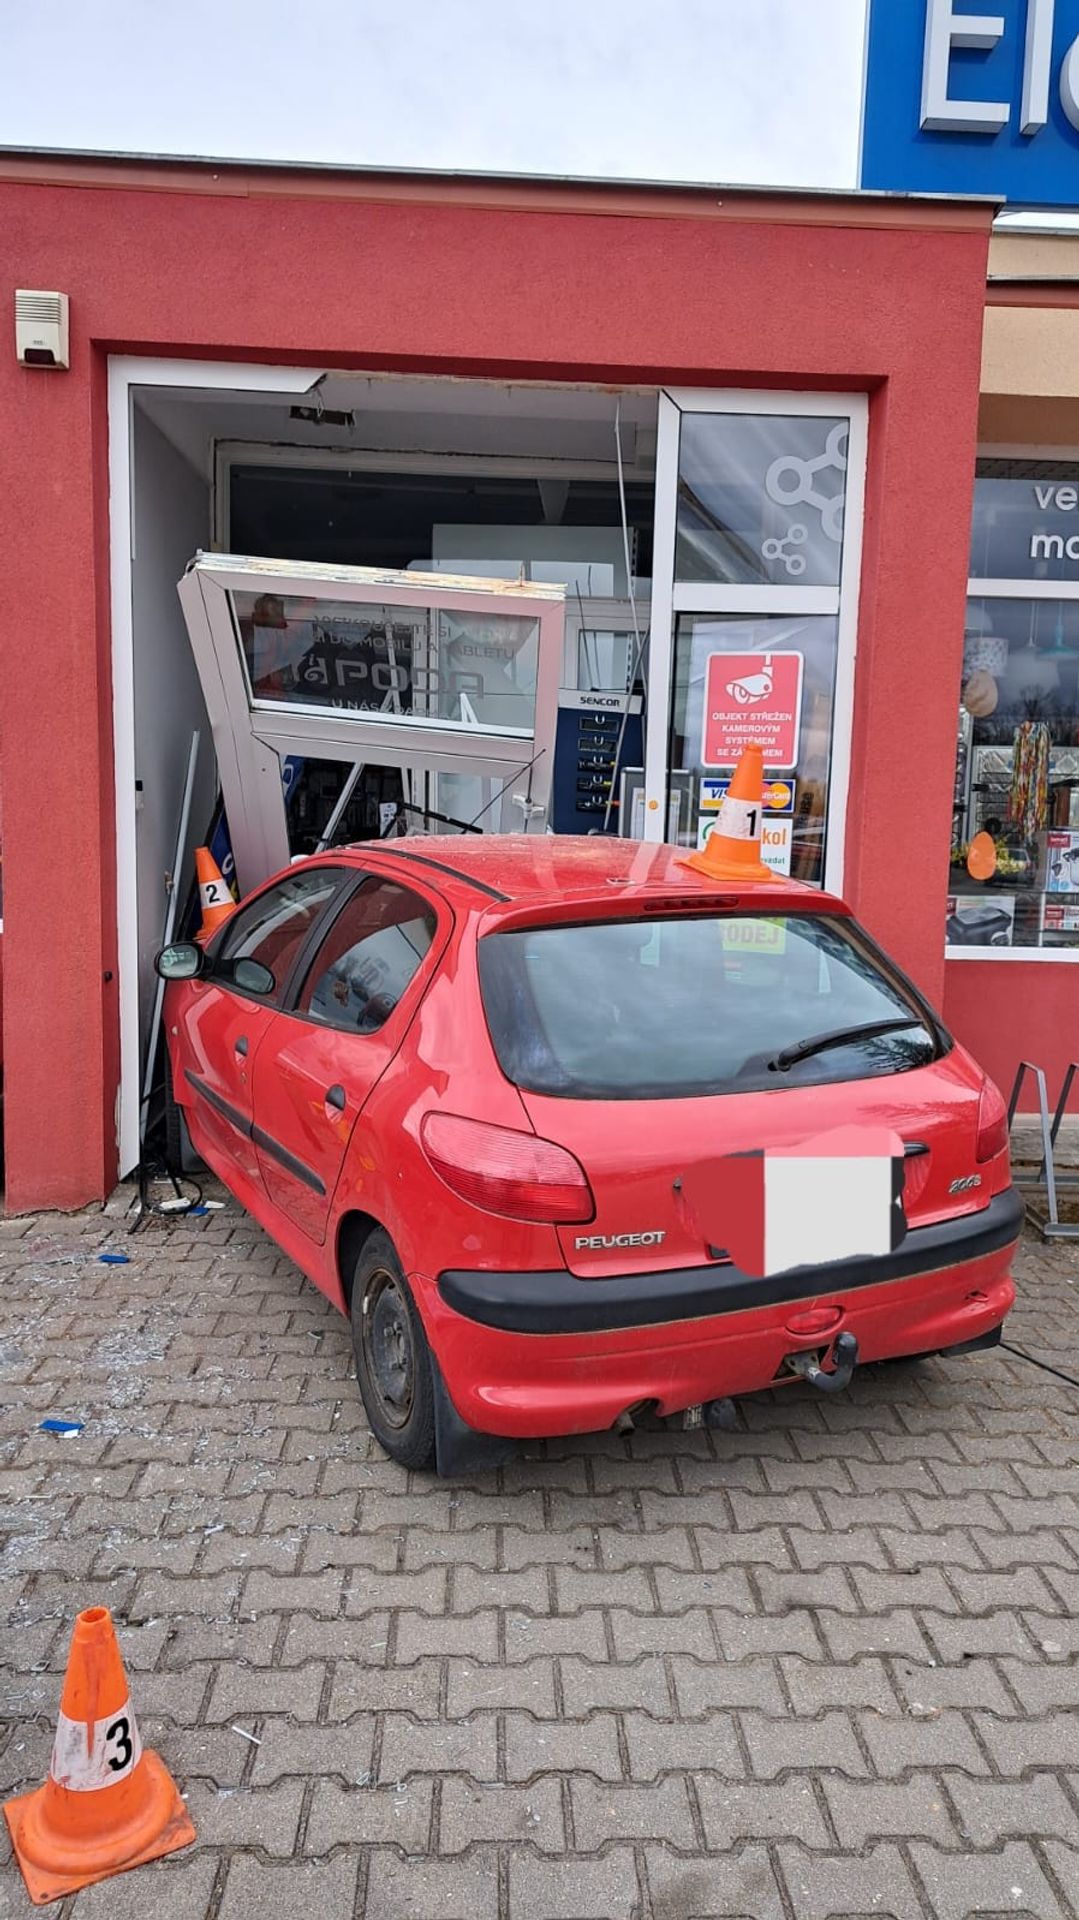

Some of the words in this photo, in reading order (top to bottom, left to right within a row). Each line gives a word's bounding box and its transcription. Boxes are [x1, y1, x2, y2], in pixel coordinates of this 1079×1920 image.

[580, 696, 620, 707] SENCOR
[712, 712, 747, 721] OBJEKT
[750, 711, 792, 721] STŘEŽEN
[721, 723, 781, 733] KAMEROVÝM
[716, 748, 729, 756] SE
[730, 746, 784, 757] ZÁMEM
[747, 809, 757, 837] 1
[205, 884, 220, 904] 2
[575, 1231, 667, 1250] PEUGEOT
[105, 1716, 133, 1772] 3
